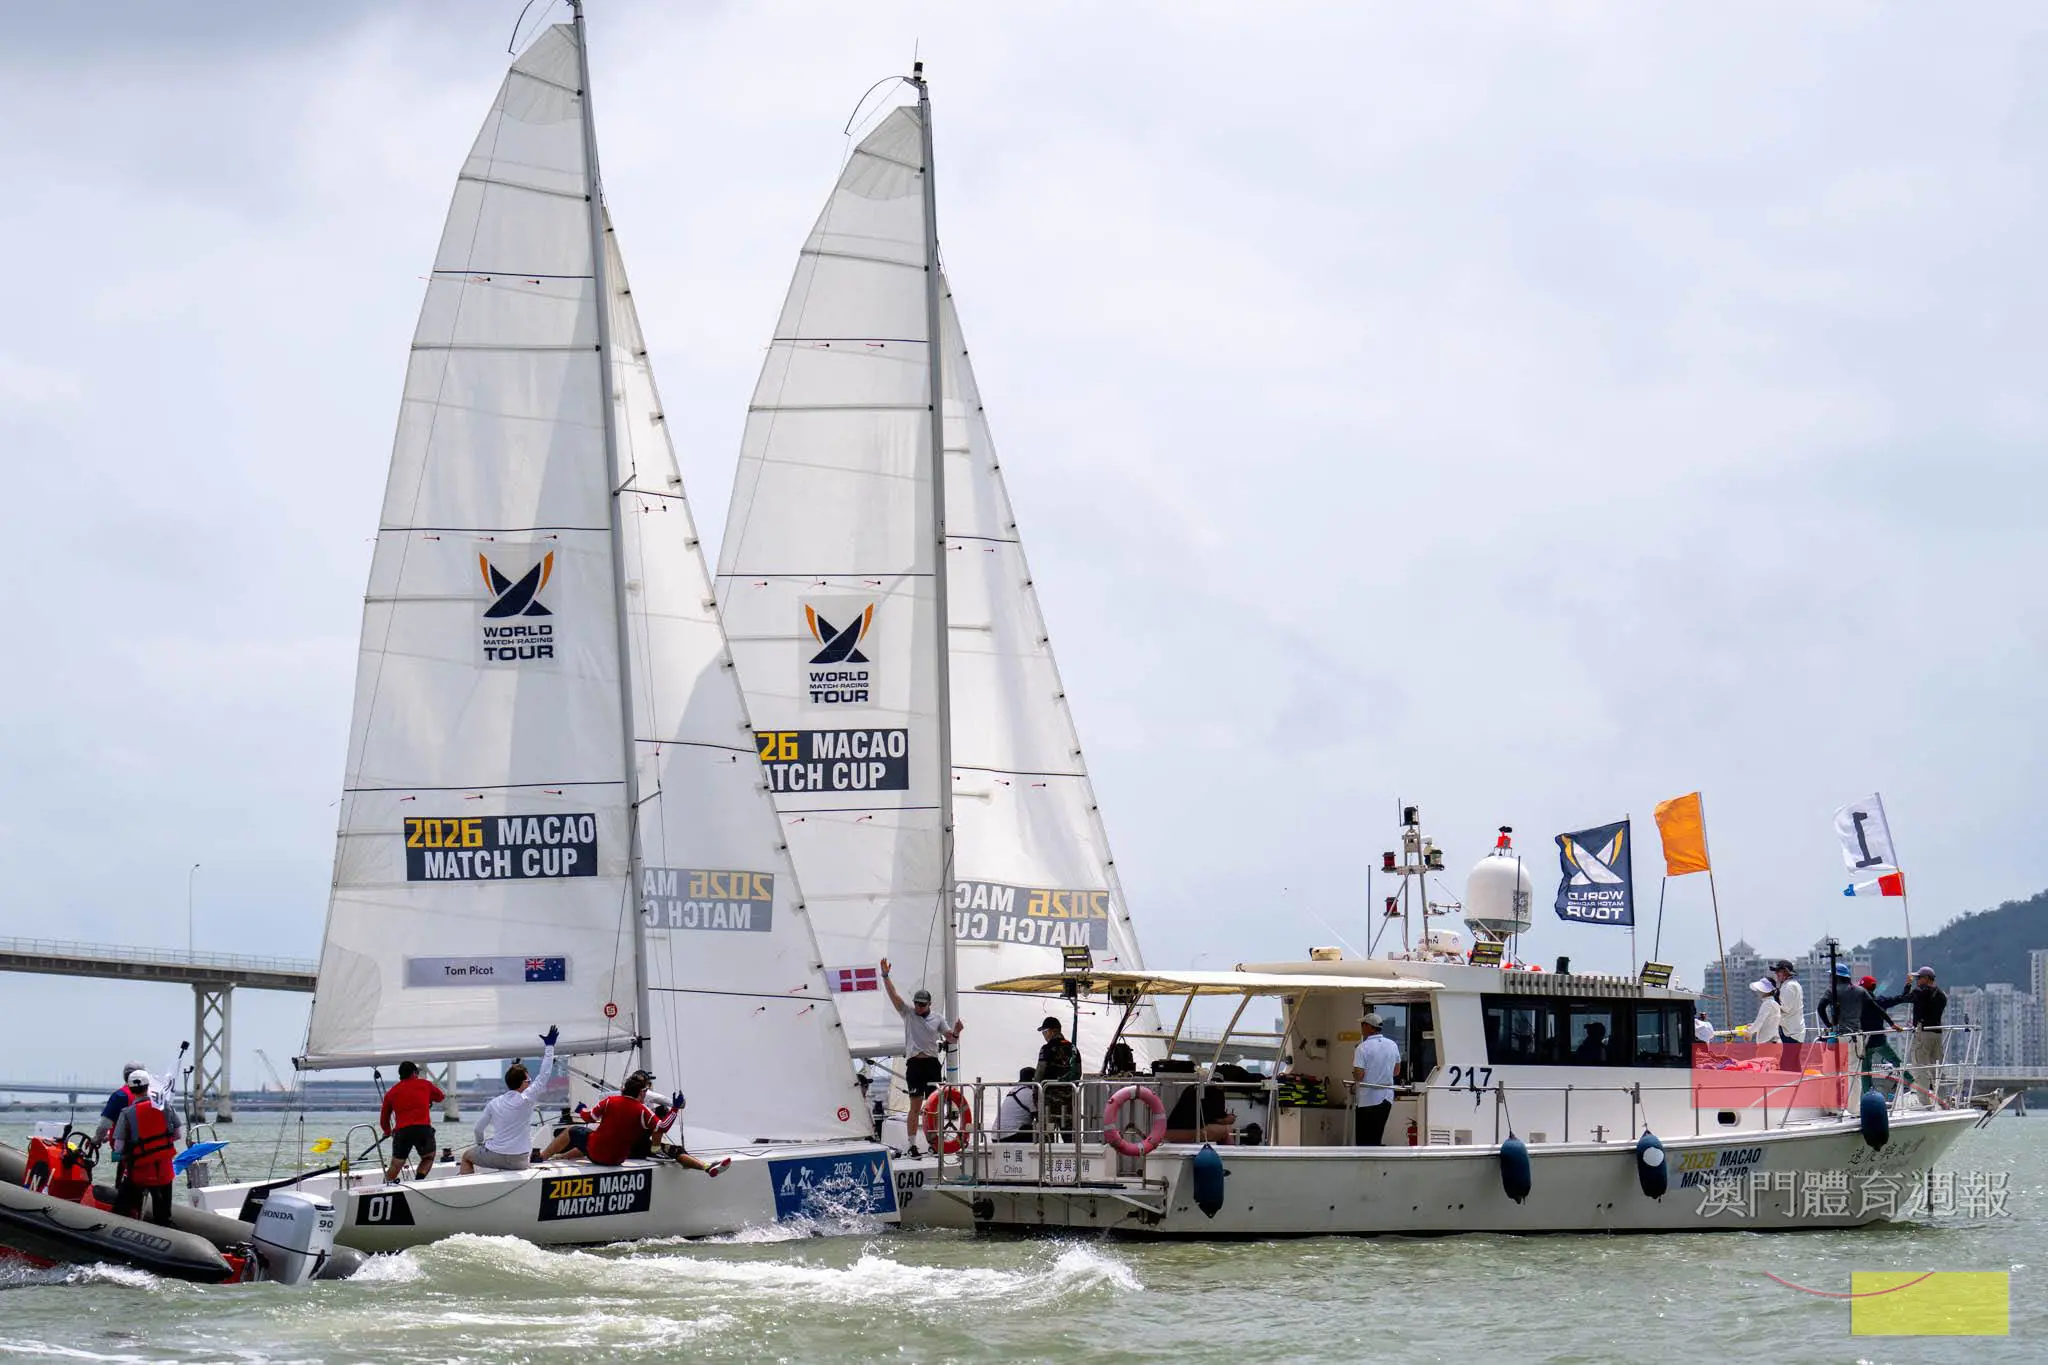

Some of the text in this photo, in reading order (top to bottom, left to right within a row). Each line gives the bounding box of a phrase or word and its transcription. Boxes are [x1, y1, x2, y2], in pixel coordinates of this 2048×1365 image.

[483, 625, 553, 637] WORLD
[483, 645, 553, 661] TOUR
[809, 671, 869, 682] WORLD
[809, 690, 869, 703] TOUR
[755, 730, 906, 761] 26 MACAO
[832, 762, 886, 789] CUP
[405, 815, 595, 848] 2026 MACAO
[424, 847, 578, 879] MATCH CUP
[445, 965, 494, 975] Tom Picot
[1449, 1065, 1493, 1092] 217
[834, 1162, 852, 1175] 2026
[1679, 1147, 1762, 1171] 2026 MACAO
[1004, 1164, 1023, 1174] China
[549, 1173, 645, 1199] 2026 MACAO
[368, 1195, 393, 1222] 01
[557, 1193, 635, 1216] MATCH CUP
[262, 1210, 294, 1221] HONDA
[318, 1219, 334, 1229] 90
